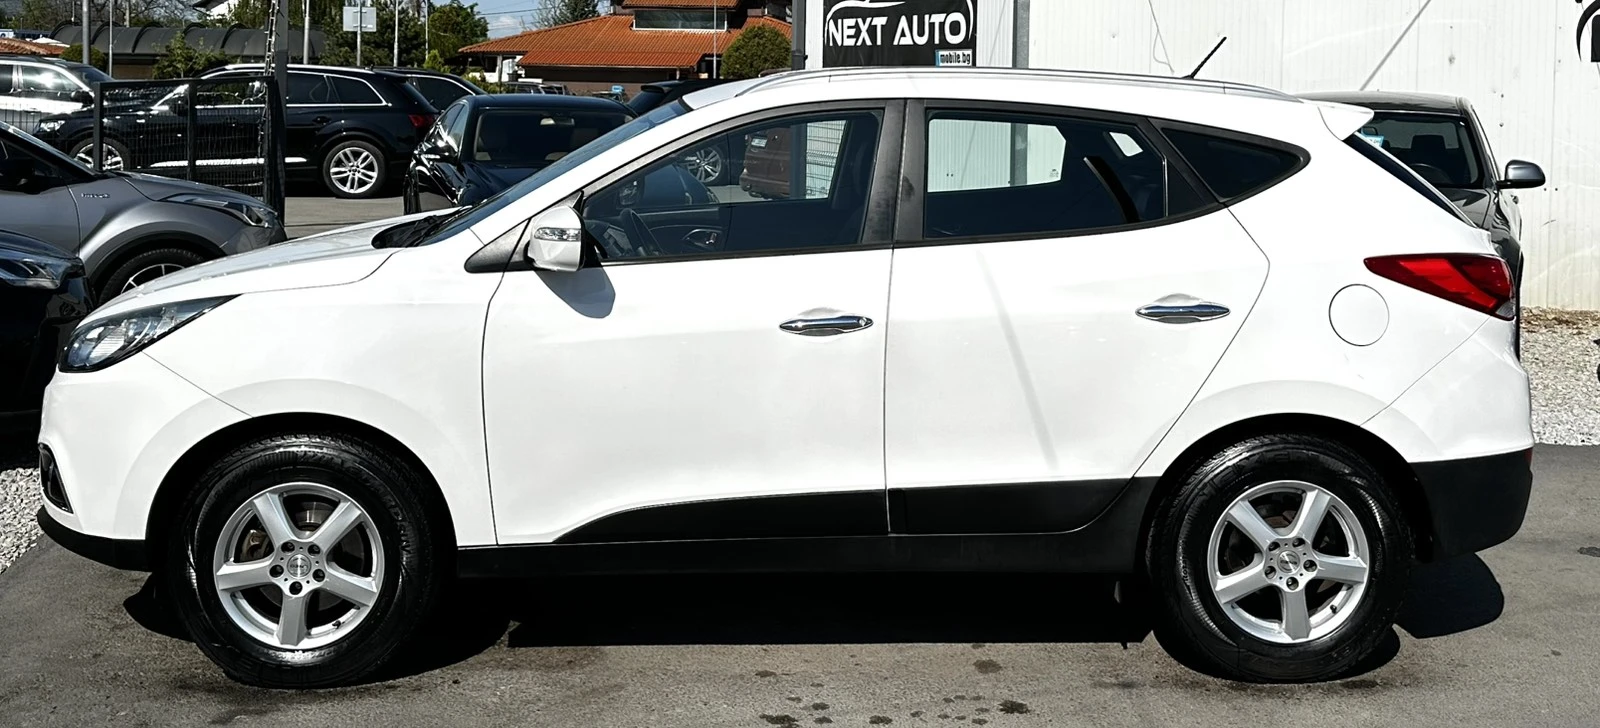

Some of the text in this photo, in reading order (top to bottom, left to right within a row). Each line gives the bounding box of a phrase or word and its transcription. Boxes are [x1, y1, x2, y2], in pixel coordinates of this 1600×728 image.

[828, 11, 967, 46] NEXT AUTO
[940, 51, 971, 65] mobile.bg
